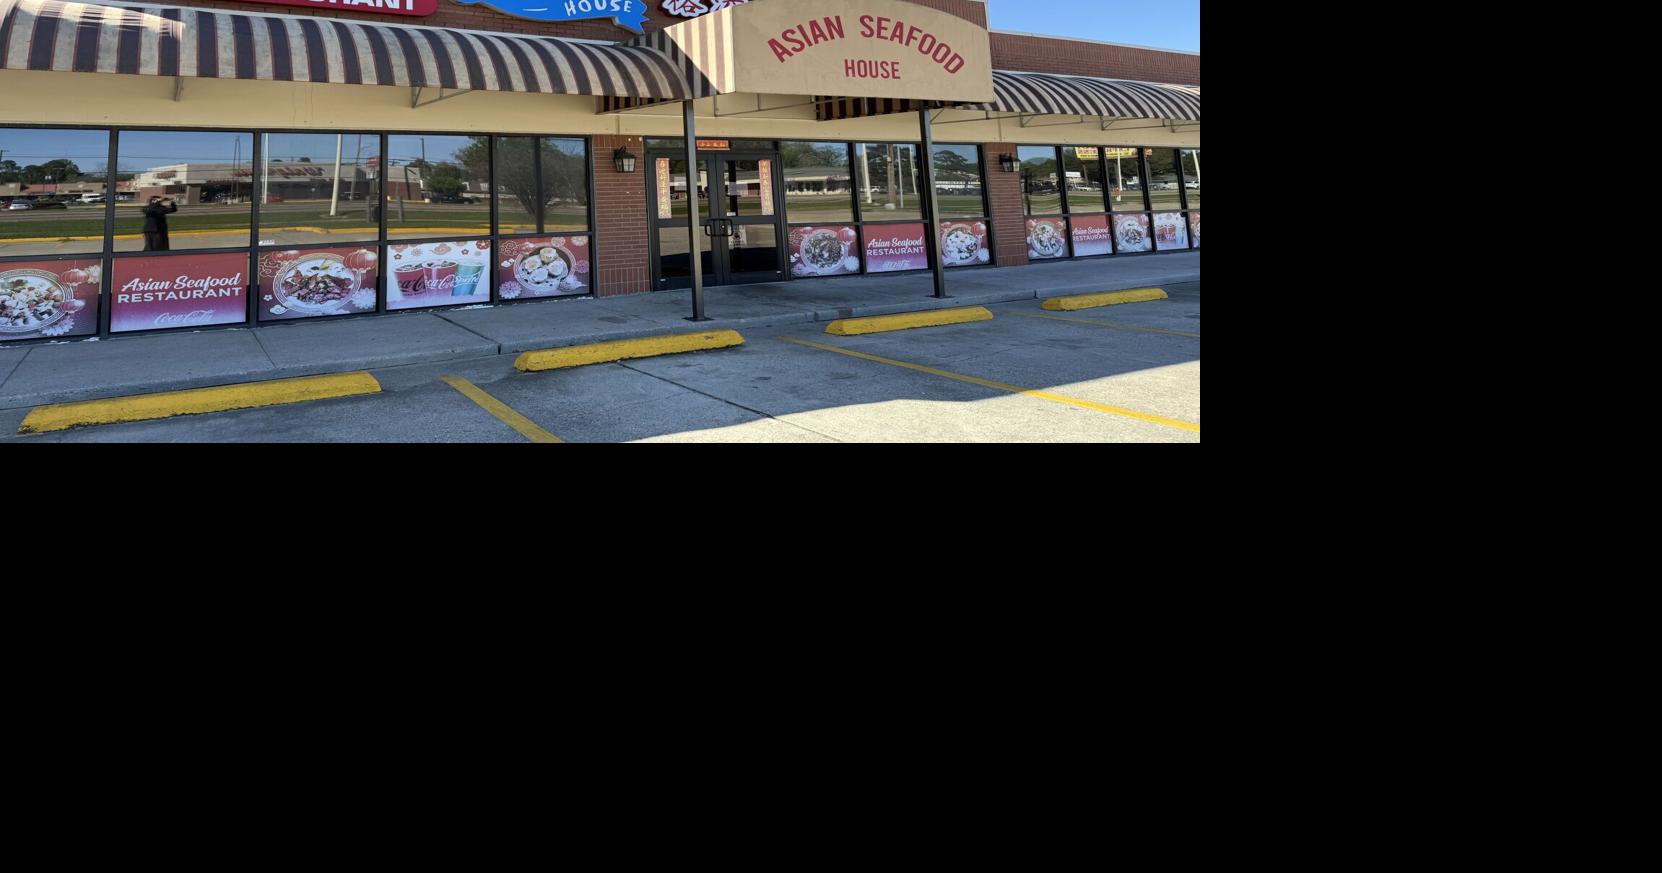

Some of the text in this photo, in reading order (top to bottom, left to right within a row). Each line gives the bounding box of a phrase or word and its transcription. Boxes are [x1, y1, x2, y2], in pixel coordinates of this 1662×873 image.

[565, 0, 632, 16] HOUSE
[767, 15, 965, 75] ASIAN SEAFOOD
[844, 59, 901, 80] HOUSE
[868, 237, 922, 249] Asian Seafood
[867, 247, 924, 256] RESTAURANT
[121, 272, 241, 292] Asian Seafood
[117, 287, 241, 303] RESTAURANT
